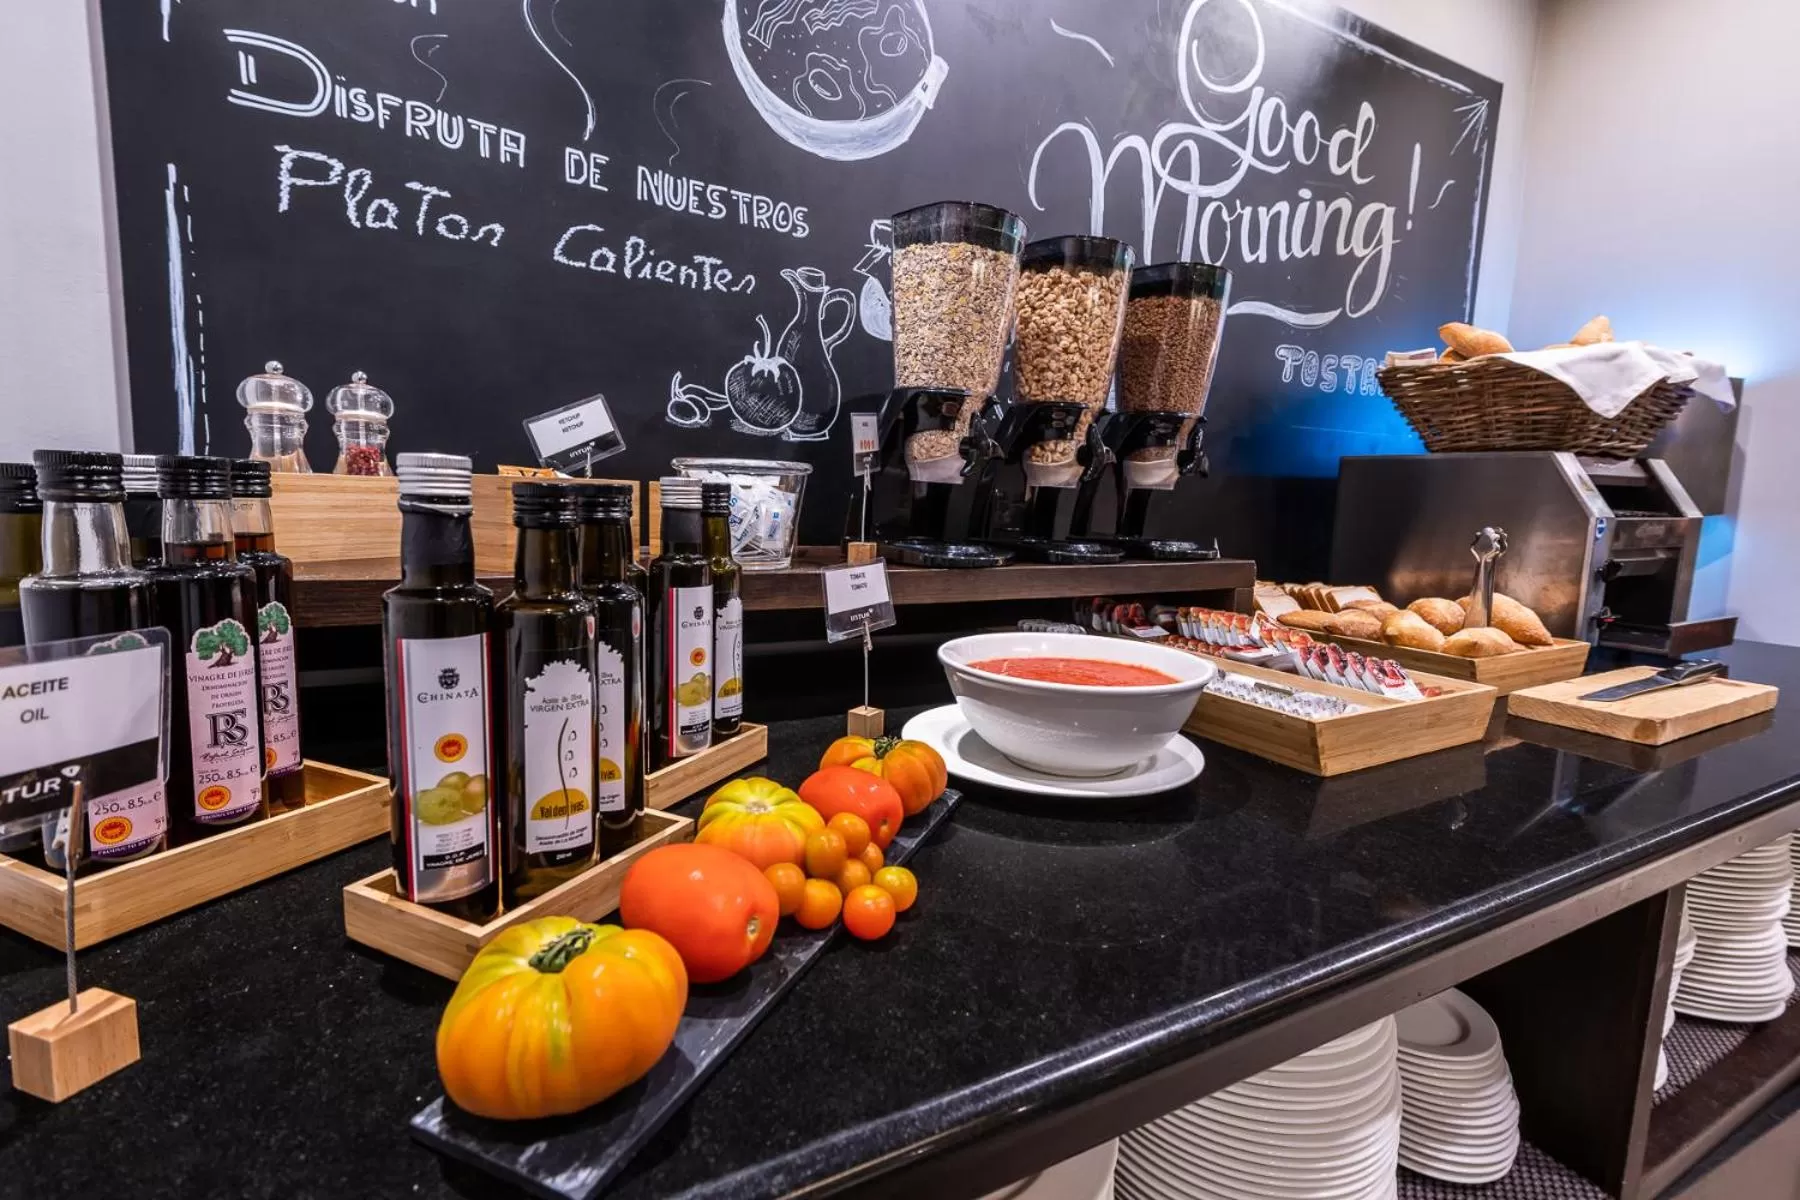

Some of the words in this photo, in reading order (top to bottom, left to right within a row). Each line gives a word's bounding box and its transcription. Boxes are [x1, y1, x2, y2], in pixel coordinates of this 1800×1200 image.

[1153, 0, 1376, 197] Good
[565, 147, 610, 192] DE
[636, 164, 810, 238] NUESTROS
[1275, 343, 1386, 396] TOSTA
[227, 670, 237, 678] DE
[2, 677, 70, 700] ACEITE
[20, 708, 49, 724] OIL
[530, 704, 564, 713] VIRGEN
